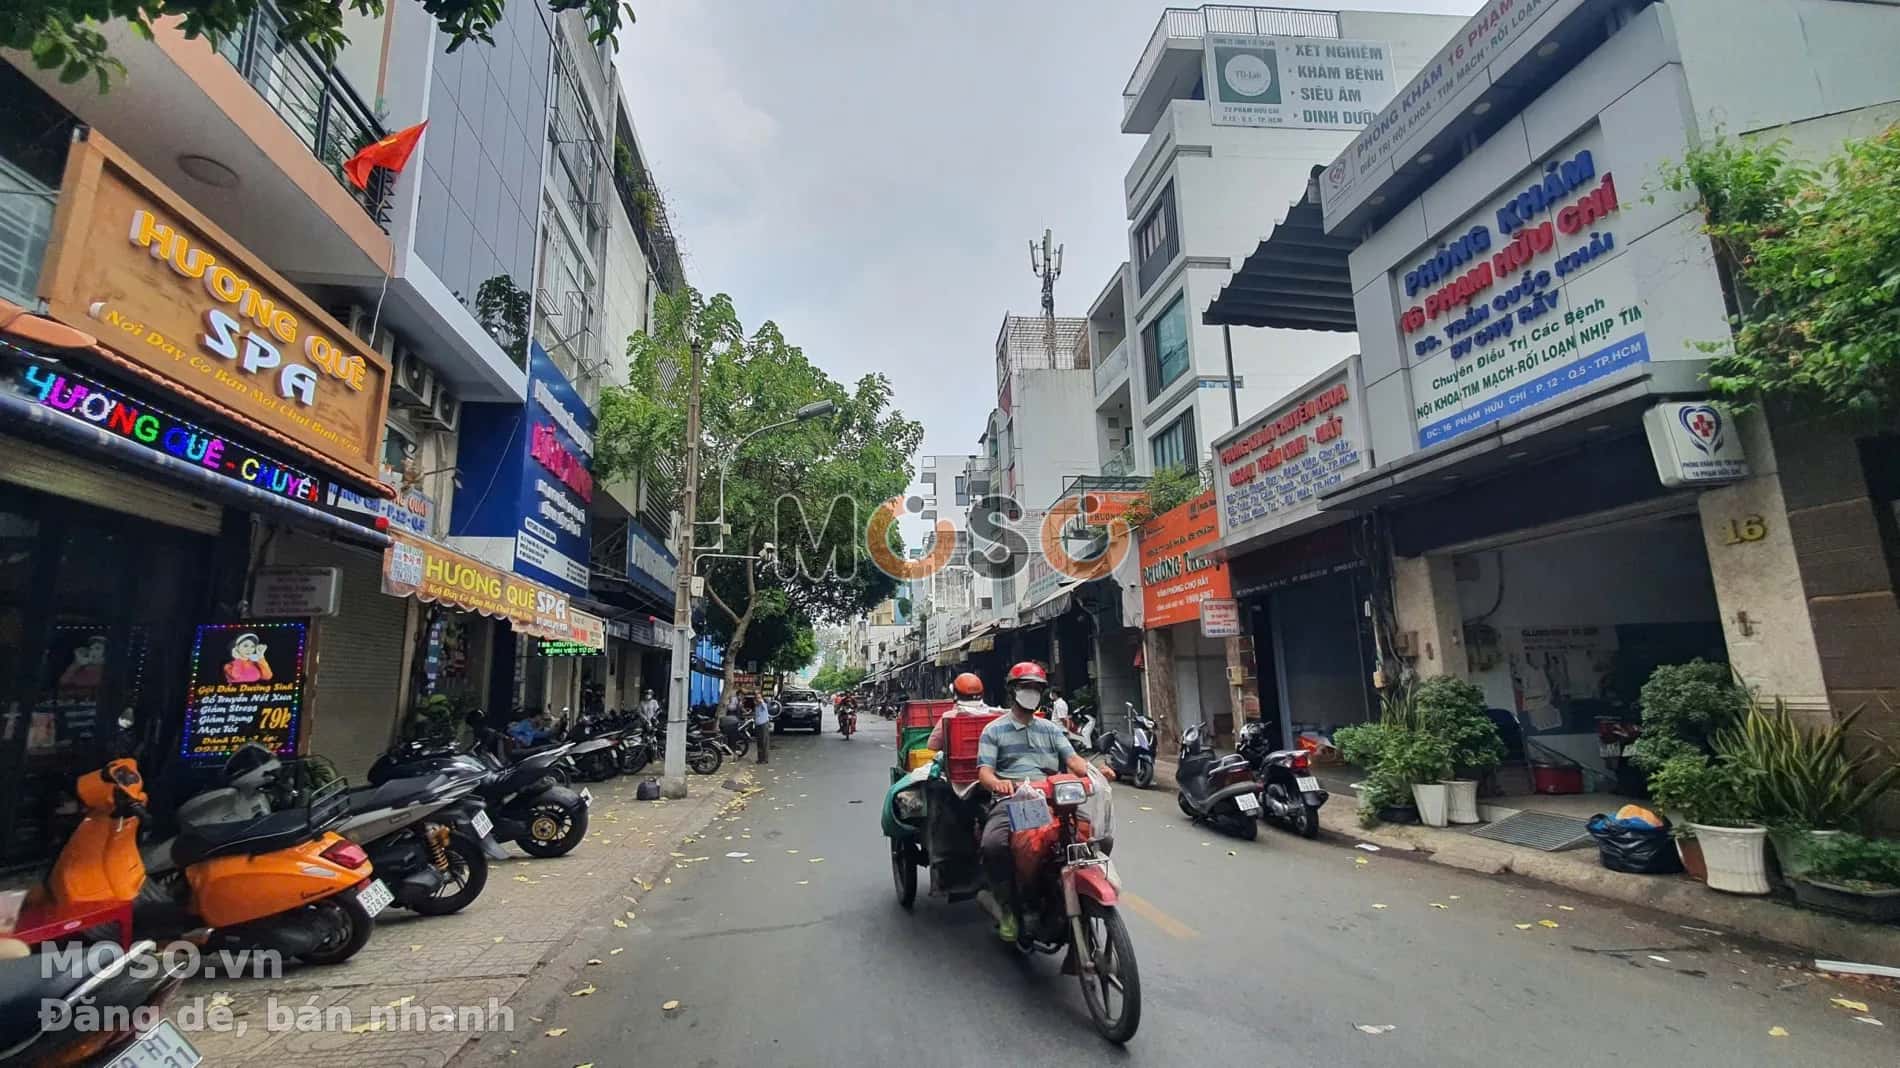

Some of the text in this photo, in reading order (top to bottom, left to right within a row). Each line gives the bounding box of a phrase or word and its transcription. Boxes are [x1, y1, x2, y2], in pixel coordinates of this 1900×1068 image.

[1295, 44, 1383, 60] XÉT NGHIỆM
[1298, 65, 1385, 82] KHÁM BỆNH
[1301, 85, 1361, 102] SIÊU ÂM
[1402, 64, 1443, 112] KHÁM
[1303, 109, 1339, 124] DINH
[1404, 150, 1596, 297] PHÒNG KHÁM
[1401, 171, 1619, 334] 16 PHẠM HỮU CHÍ
[130, 210, 367, 392] HƯƠNG QUÊ
[1443, 304, 1489, 338] TRẦN
[1492, 269, 1551, 311] QUỐC
[200, 310, 318, 407] SPA
[1432, 298, 1605, 390] Chuyên Điều Trị Các Bệnh
[1450, 336, 1472, 360] BV
[1474, 313, 1514, 346] CHỢ
[1416, 402, 1433, 419] NỘI
[1541, 336, 1577, 358] LOẠN
[1580, 318, 1614, 344] NHỊP
[1455, 410, 1480, 427] PHẠM
[1724, 514, 1767, 545] 16
[426, 555, 501, 599] HƯƠNG
[506, 585, 535, 610] QUÊ
[537, 591, 567, 620] SPA
[228, 704, 258, 713] Stress
